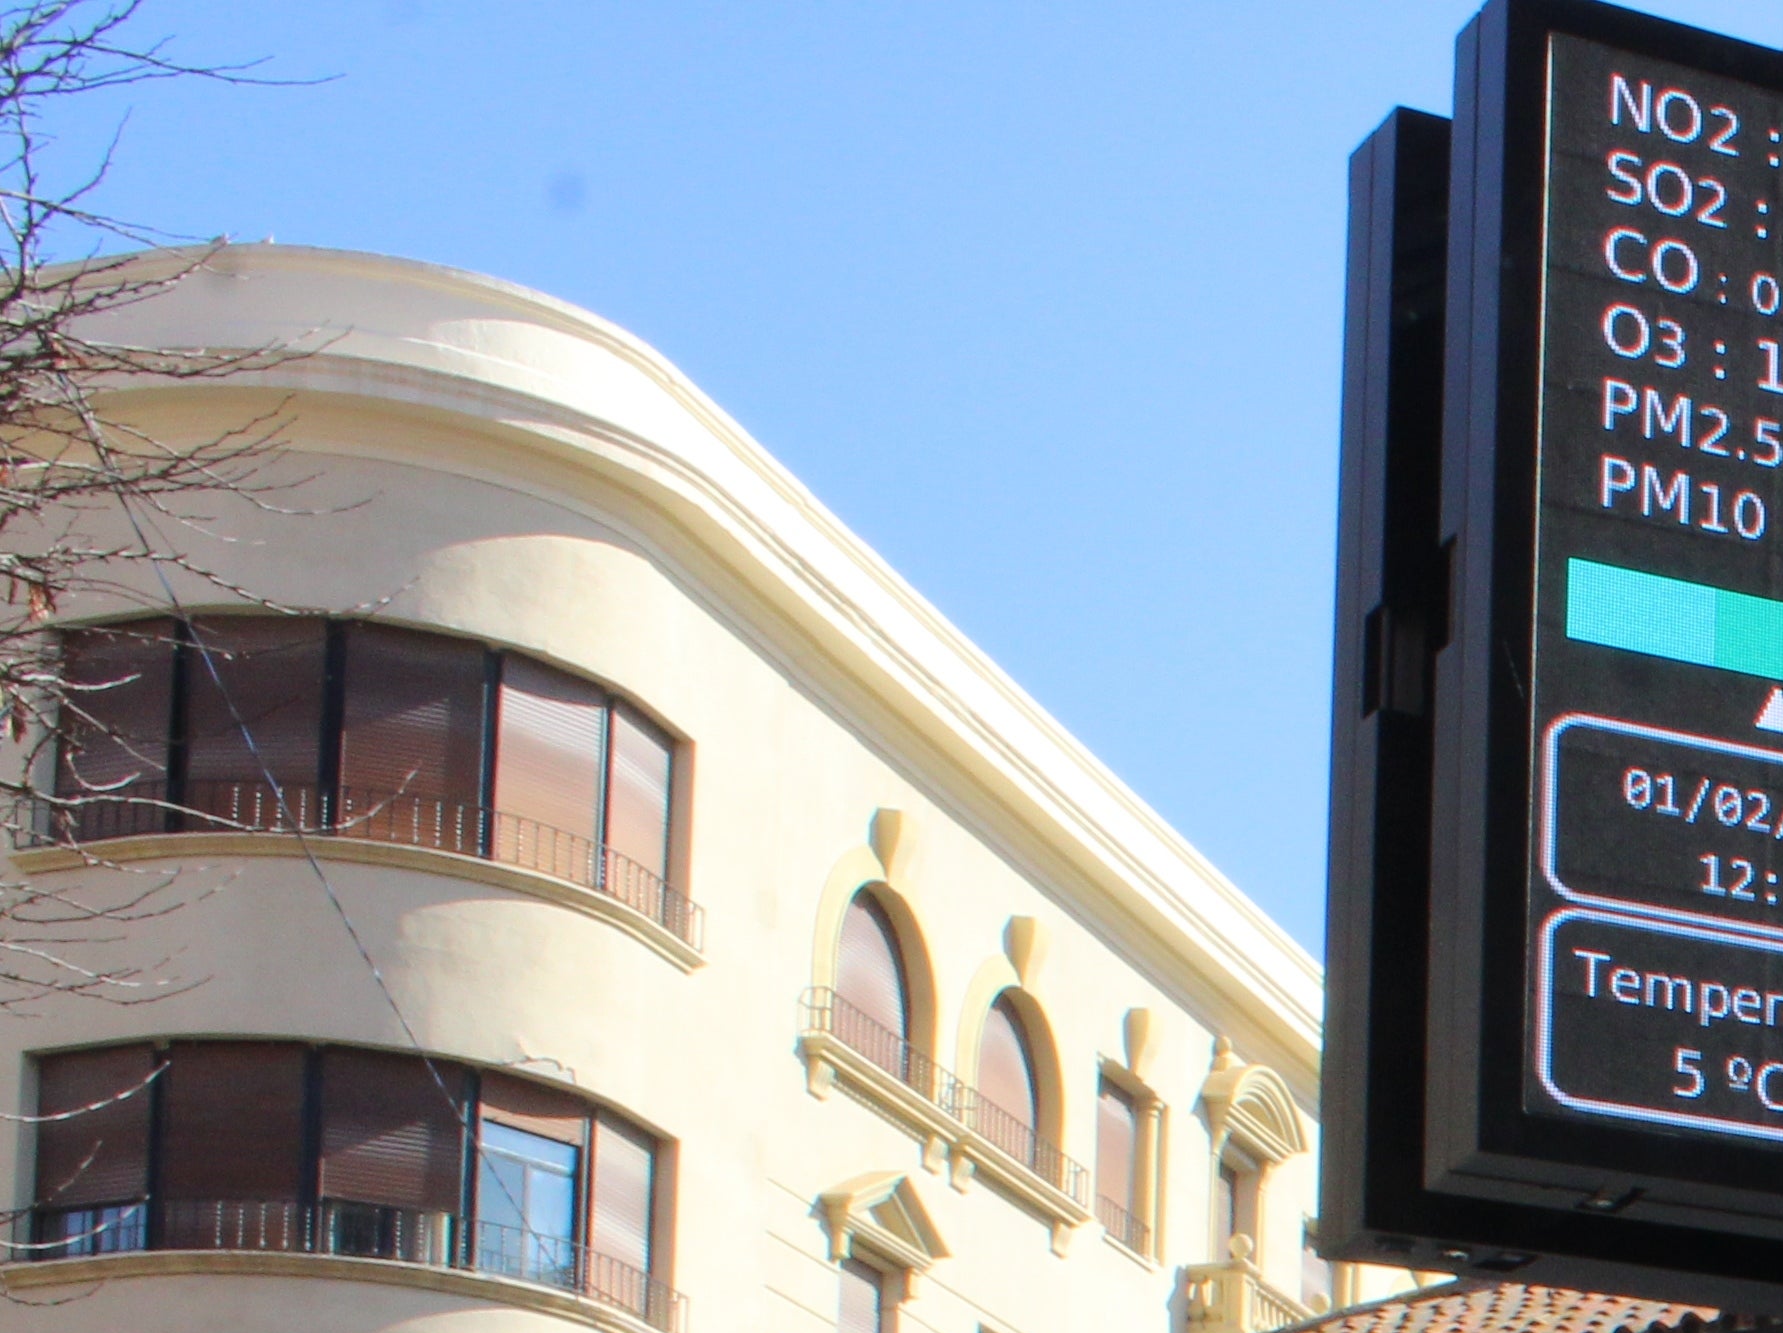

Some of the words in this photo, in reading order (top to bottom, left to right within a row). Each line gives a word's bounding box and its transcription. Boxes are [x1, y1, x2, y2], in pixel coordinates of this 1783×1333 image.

[1610, 74, 1739, 156] NO2
[1768, 129, 1781, 168] :
[1605, 150, 1726, 228] SO2
[1755, 201, 1768, 239] :
[1603, 227, 1699, 294] CO
[1601, 303, 1686, 369] O3
[1713, 341, 1726, 380] :
[1602, 378, 1783, 468] PM2.5
[1600, 455, 1766, 540] PM10
[1672, 1046, 1705, 1098] 5
